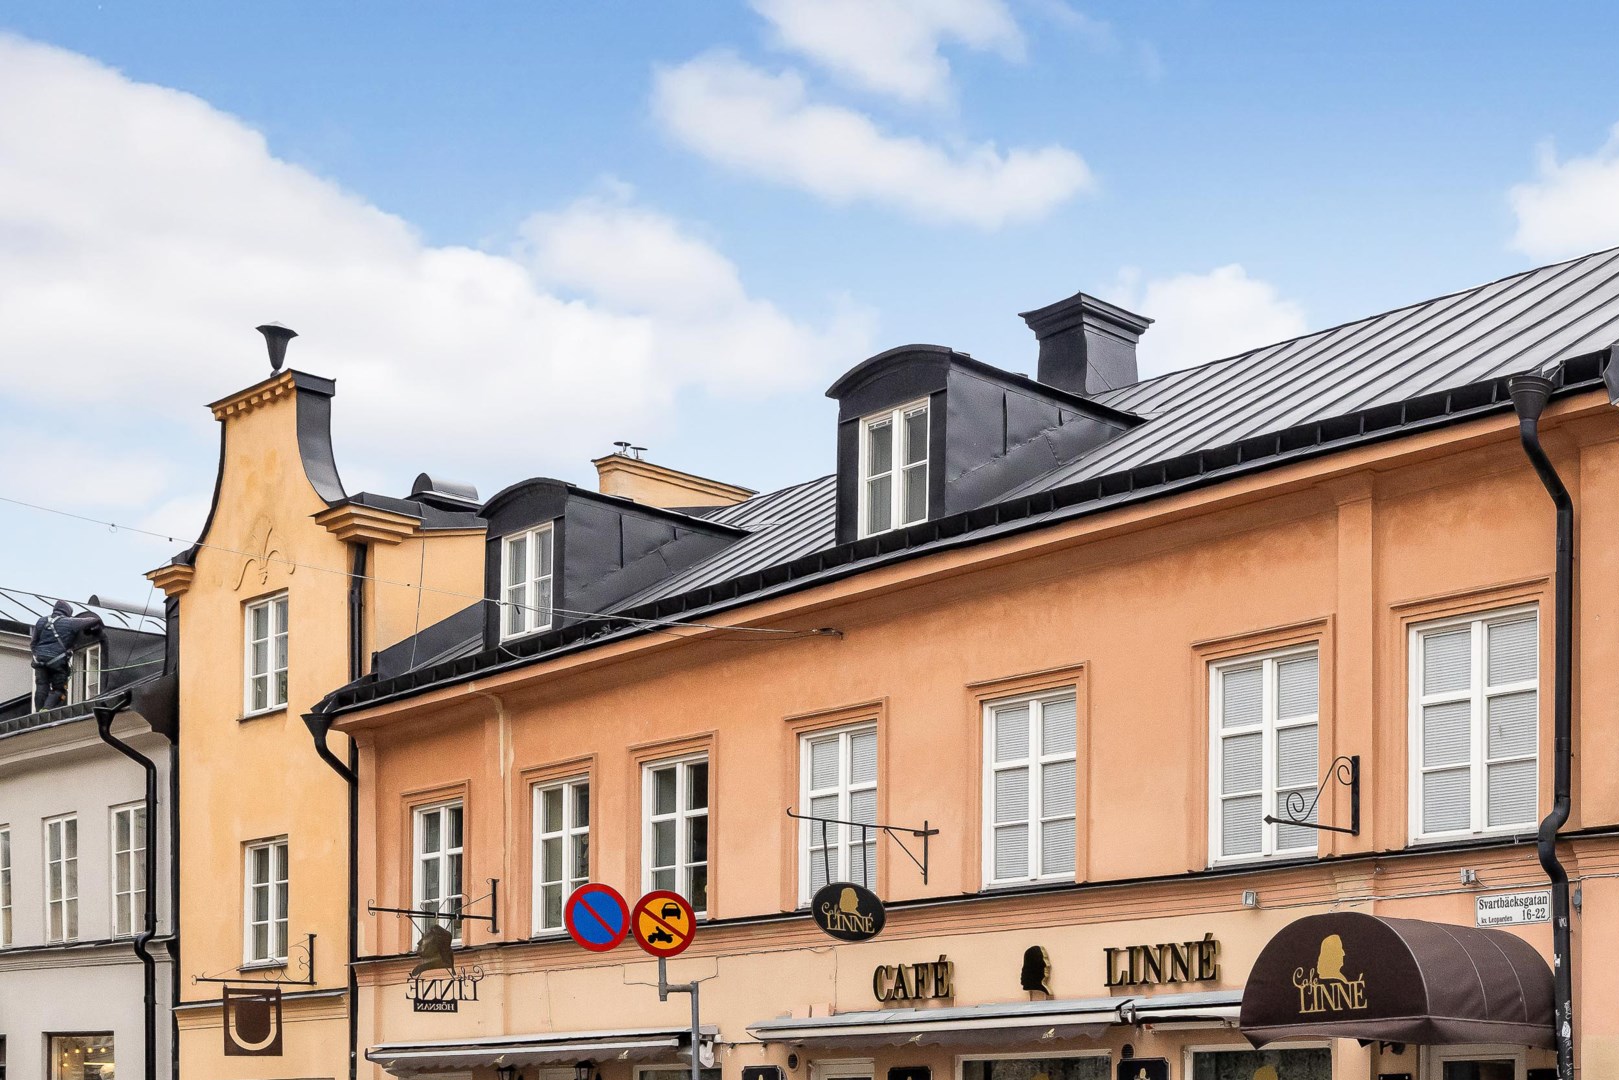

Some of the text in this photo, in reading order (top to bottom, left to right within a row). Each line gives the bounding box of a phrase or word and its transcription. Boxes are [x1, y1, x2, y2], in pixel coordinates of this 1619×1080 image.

[1478, 894, 1548, 910] Svartbäcksgatan
[826, 912, 875, 934] LINNÉ
[1522, 907, 1546, 921] 16-22
[872, 932, 1222, 1002] CAFÉ LINNÉ
[1298, 972, 1368, 1014] LINNÉ
